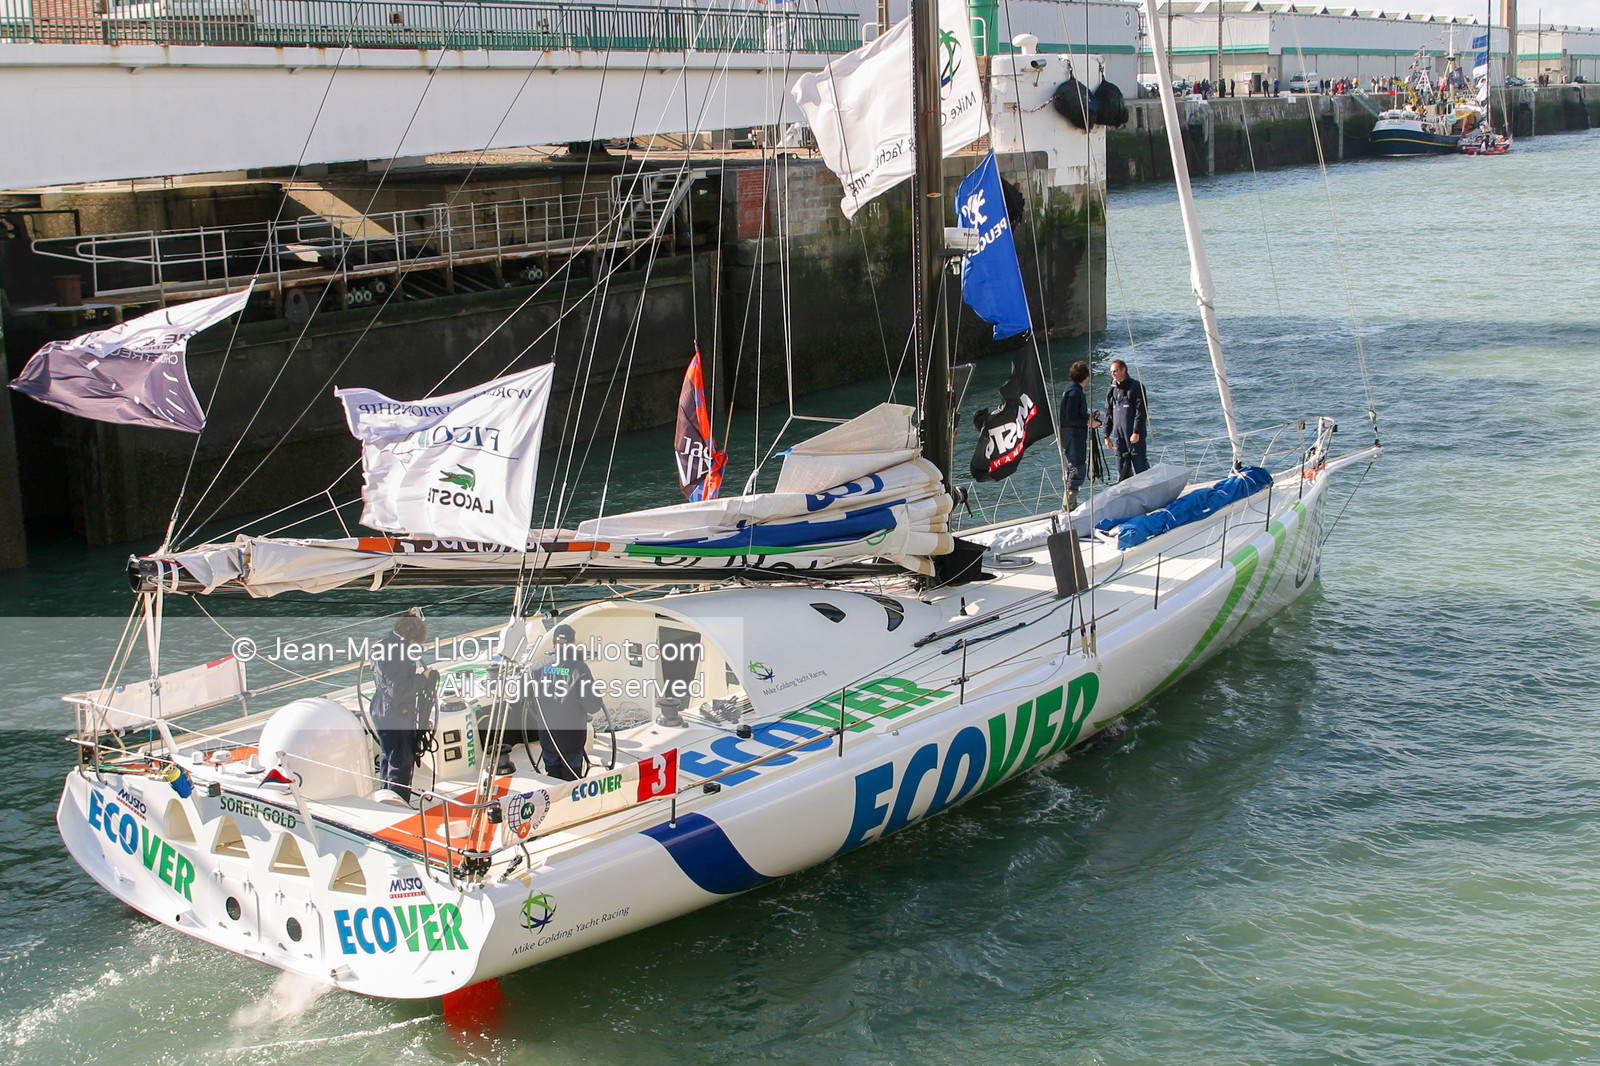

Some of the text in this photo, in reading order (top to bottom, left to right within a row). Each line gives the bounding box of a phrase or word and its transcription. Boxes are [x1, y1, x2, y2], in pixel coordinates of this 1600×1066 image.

[1125, 11, 1131, 26] 3
[543, 666, 570, 676] ECOVER
[464, 714, 477, 768] ECOVER
[680, 677, 956, 786] ECOVER
[571, 755, 667, 801] ECOVER 3
[831, 672, 1099, 857] ECOVER
[118, 788, 148, 814] MUSTO
[220, 796, 297, 829] SOREN GOLD
[89, 789, 196, 903] ECOVER
[389, 877, 423, 892] MUSTO
[334, 902, 469, 955] ECOVER
[512, 905, 630, 957] Mike Golding Yacht Racing
